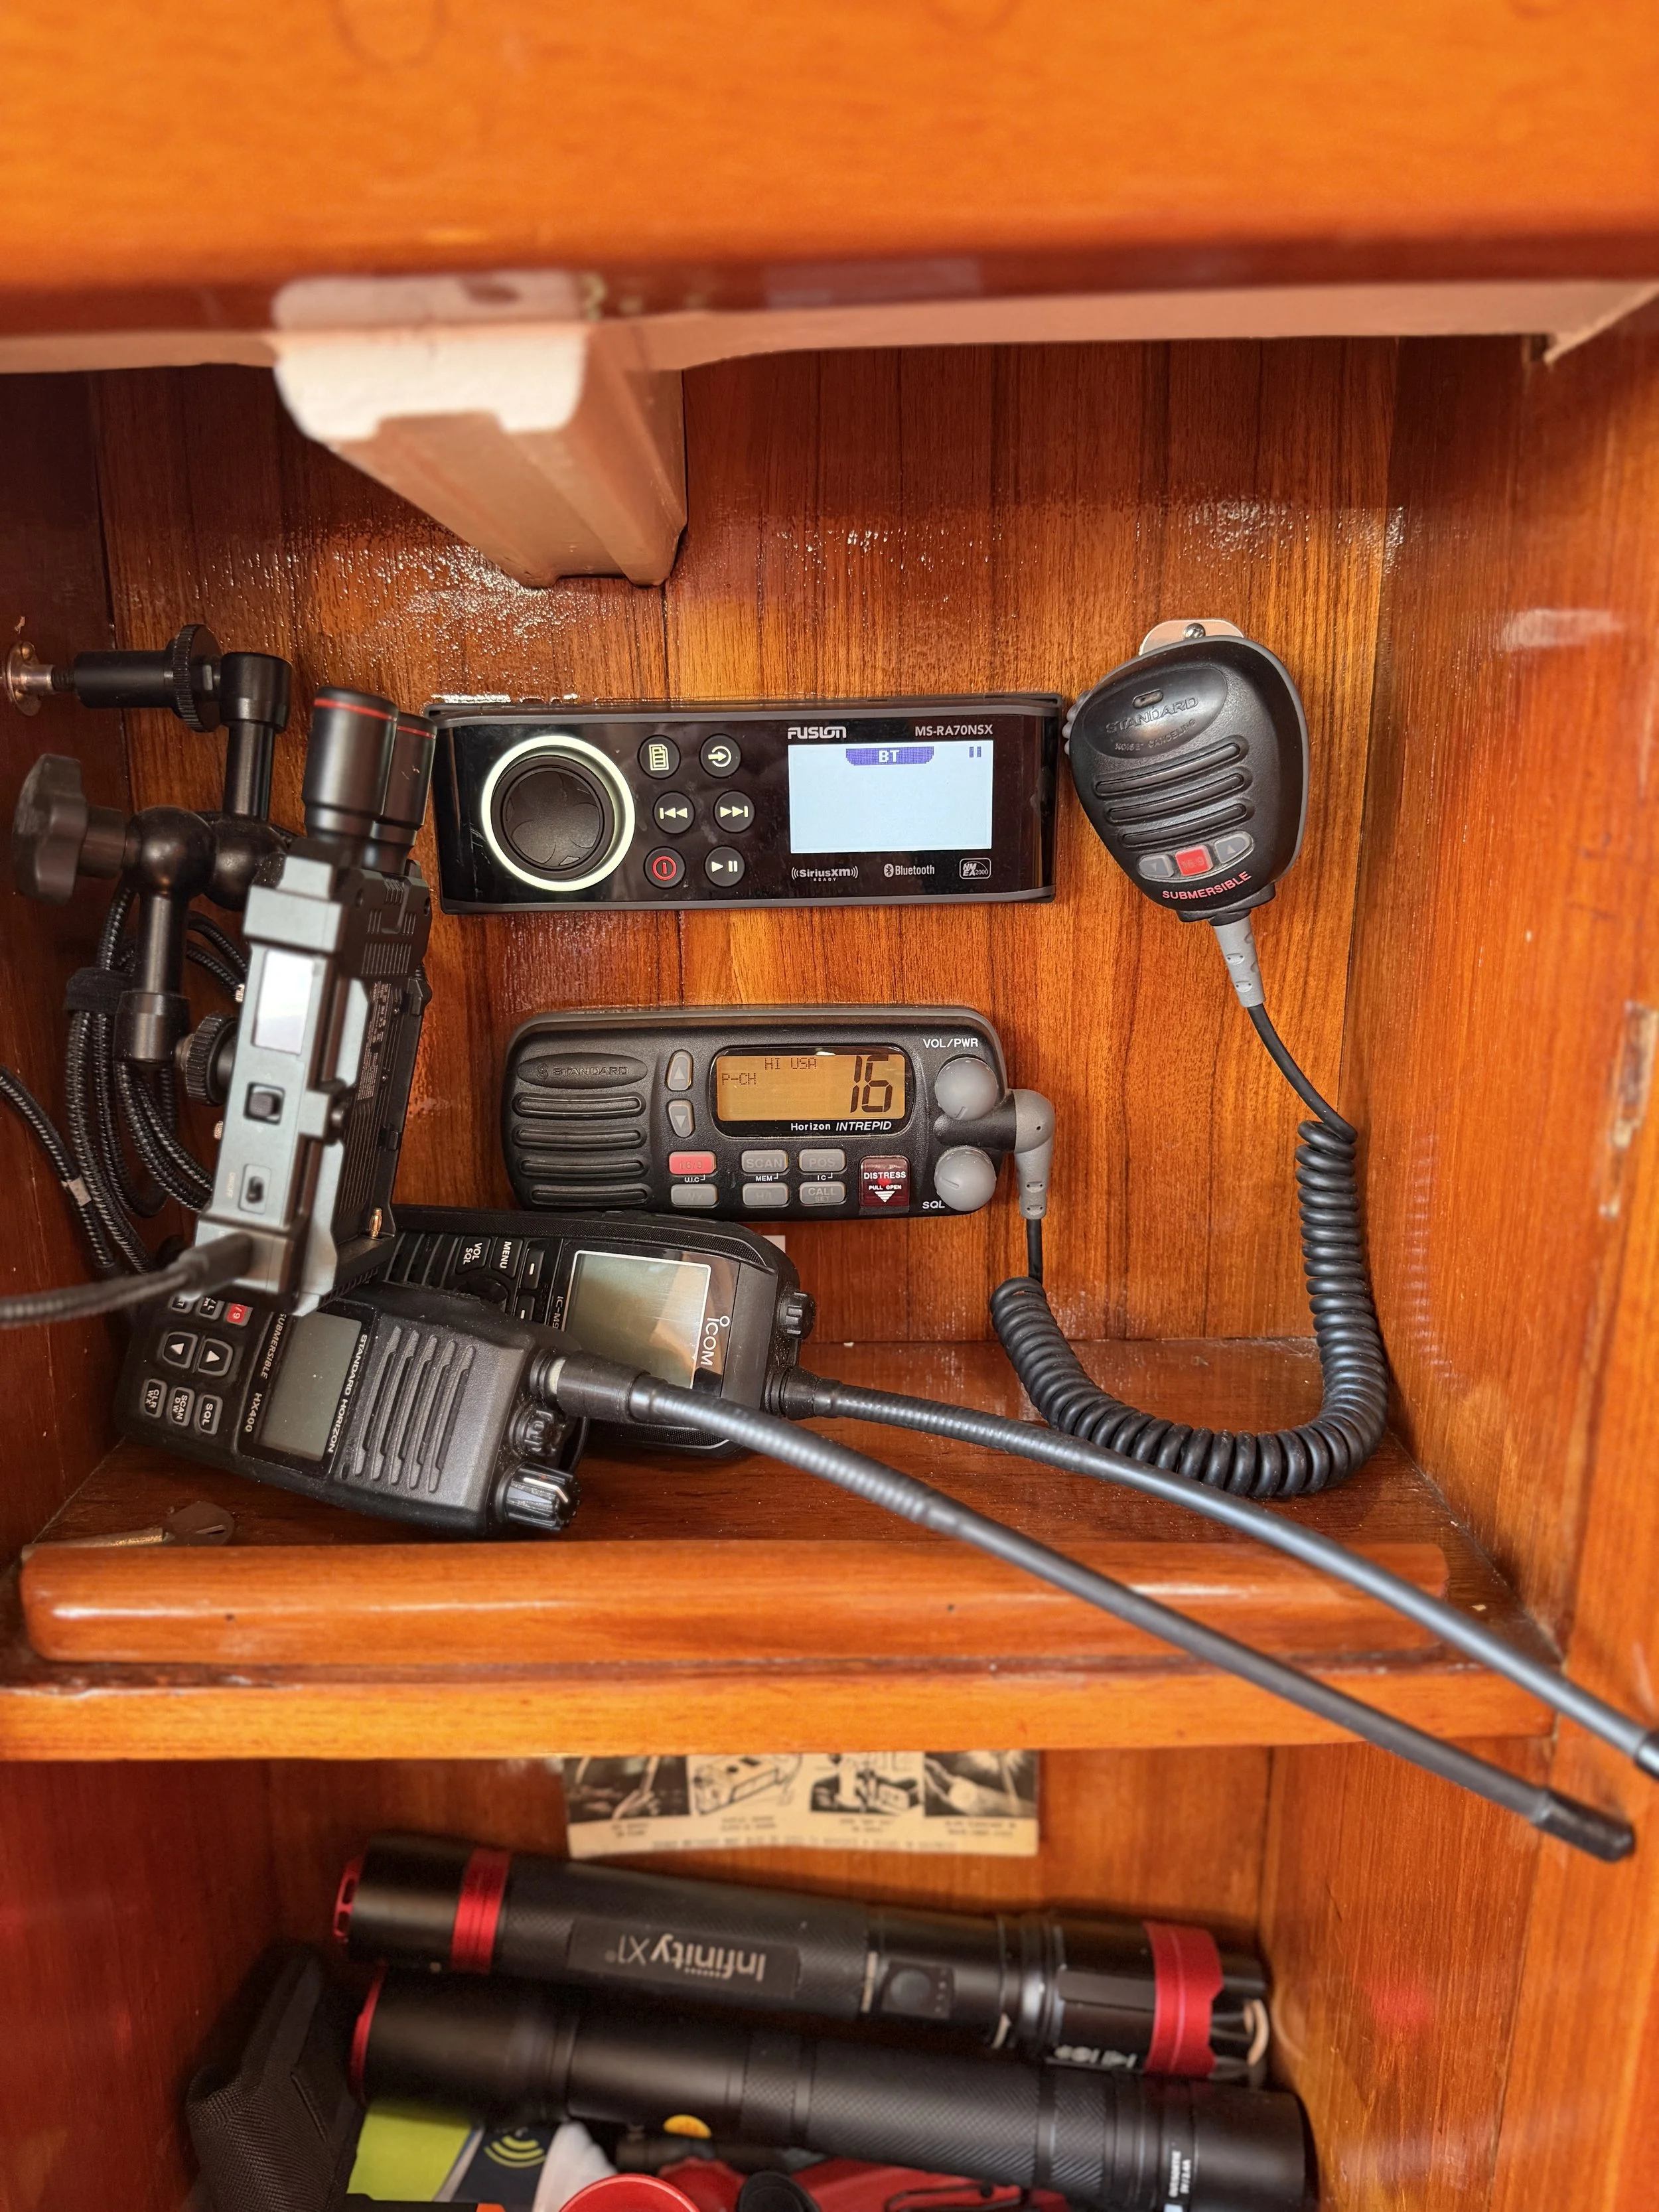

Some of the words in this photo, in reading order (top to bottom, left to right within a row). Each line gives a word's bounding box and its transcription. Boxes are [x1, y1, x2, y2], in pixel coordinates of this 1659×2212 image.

[1106, 697, 1199, 733] STANDARD
[788, 726, 847, 739] FUSION
[915, 724, 993, 737] MS-RA70NSX
[878, 749, 900, 763] BT
[895, 865, 935, 875] Bluetooth
[1162, 871, 1252, 900] SUBMERSIBLE
[922, 1037, 979, 1049] VOL/PWR
[552, 1067, 628, 1076] STANDARD
[764, 1057, 781, 1070] HI
[790, 1057, 817, 1070] USA
[721, 1072, 757, 1085] P-CH
[850, 1055, 893, 1113] 16
[790, 1122, 831, 1132] Horizon
[835, 1121, 893, 1132] INTREPID
[678, 1161, 703, 1170] 16/9
[746, 1157, 783, 1169] SCAN
[808, 1157, 836, 1167] POS
[922, 1200, 946, 1209] SQL
[463, 1247, 472, 1265] SQL
[471, 1242, 483, 1261] VOL
[499, 1240, 512, 1270] MENU
[552, 1295, 564, 1328] IC-M9
[261, 1313, 287, 1380] SUBMERSIBLE
[344, 1333, 368, 1396] STANDARD
[145, 1390, 155, 1405] WX
[149, 1389, 160, 1409] CLR
[175, 1394, 188, 1420] SCAN
[201, 1403, 214, 1426] SQL
[244, 1392, 263, 1434] HX400
[327, 1398, 349, 1453] HORIZON
[618, 1935, 651, 1966] X1
[650, 1933, 767, 1982] Infinity
